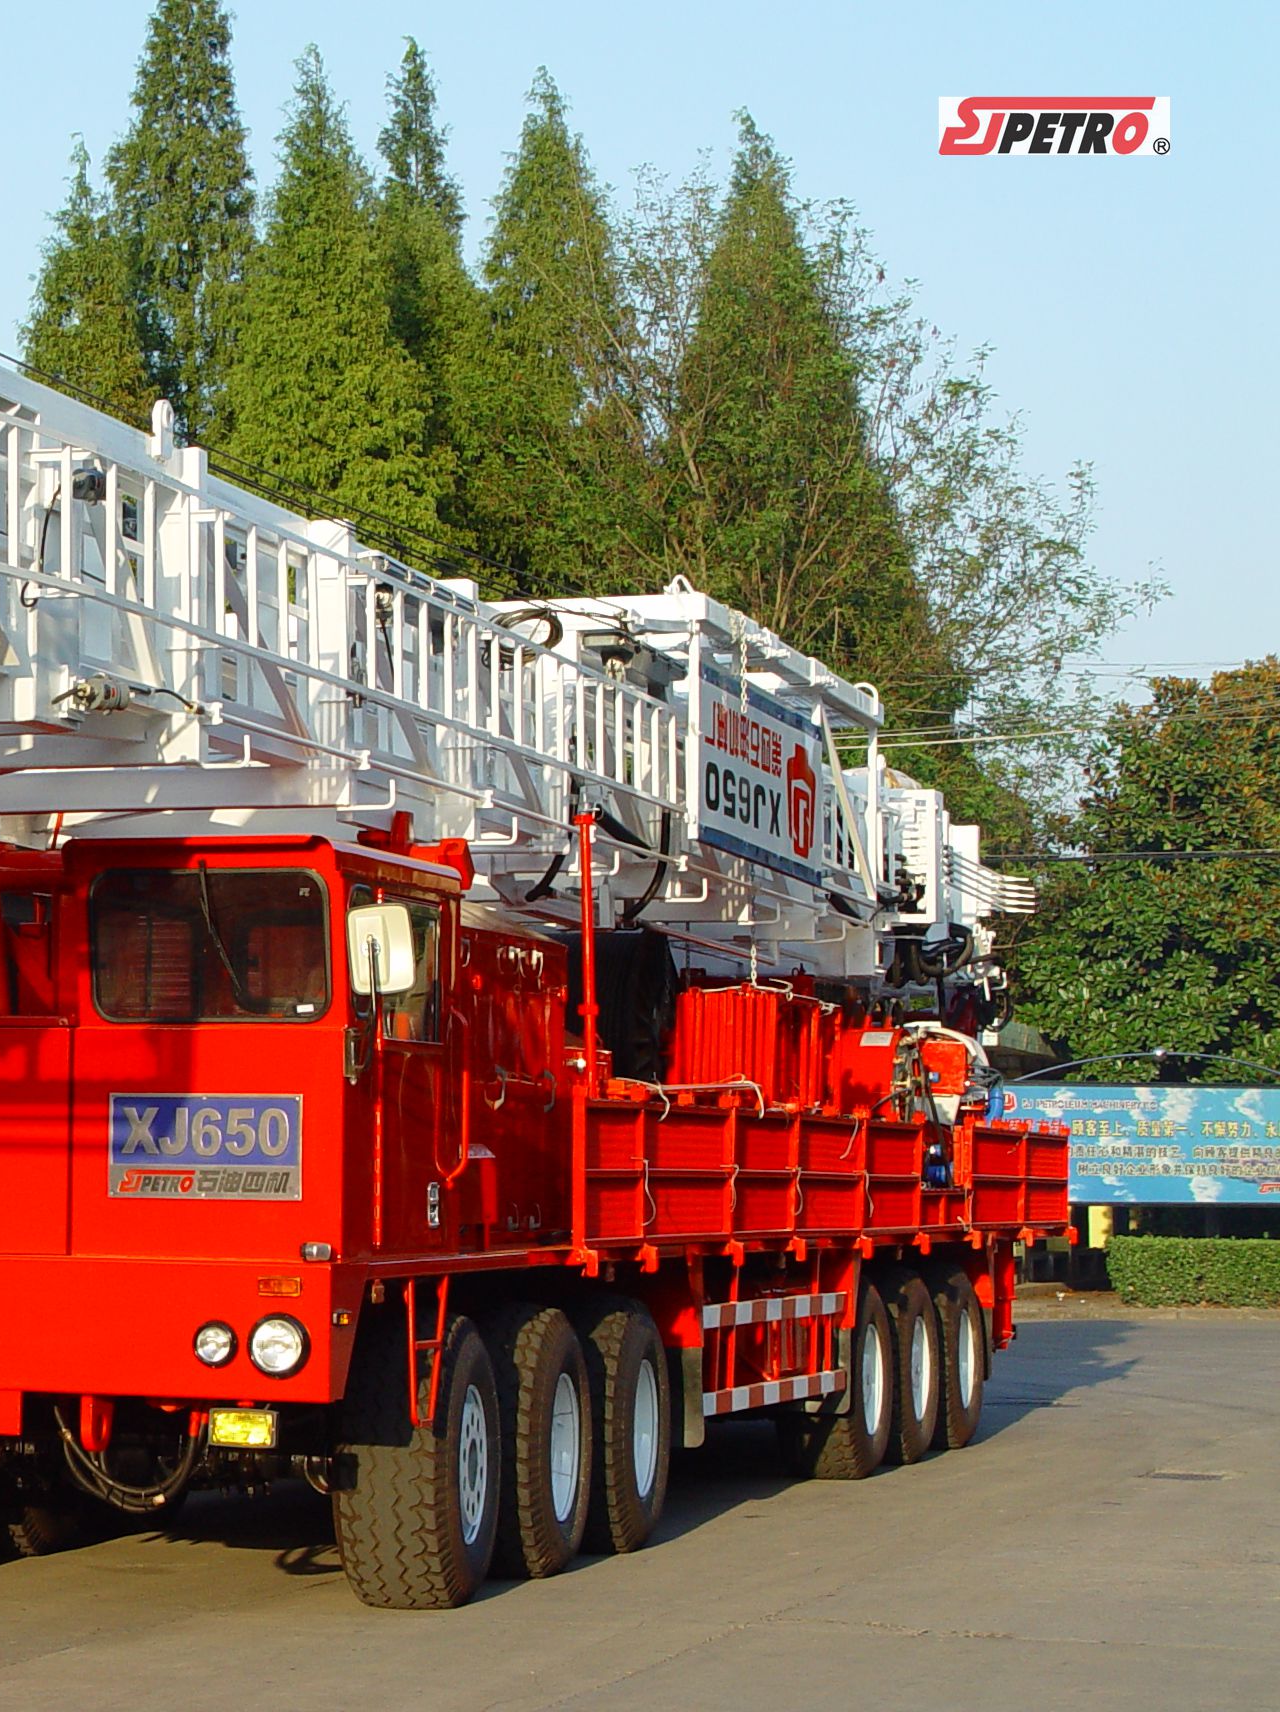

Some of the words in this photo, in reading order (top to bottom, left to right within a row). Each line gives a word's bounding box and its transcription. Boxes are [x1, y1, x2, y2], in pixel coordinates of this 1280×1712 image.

[705, 761, 781, 837] XJ650
[121, 1107, 290, 1157] XJ650
[197, 1168, 290, 1193] 石油四机
